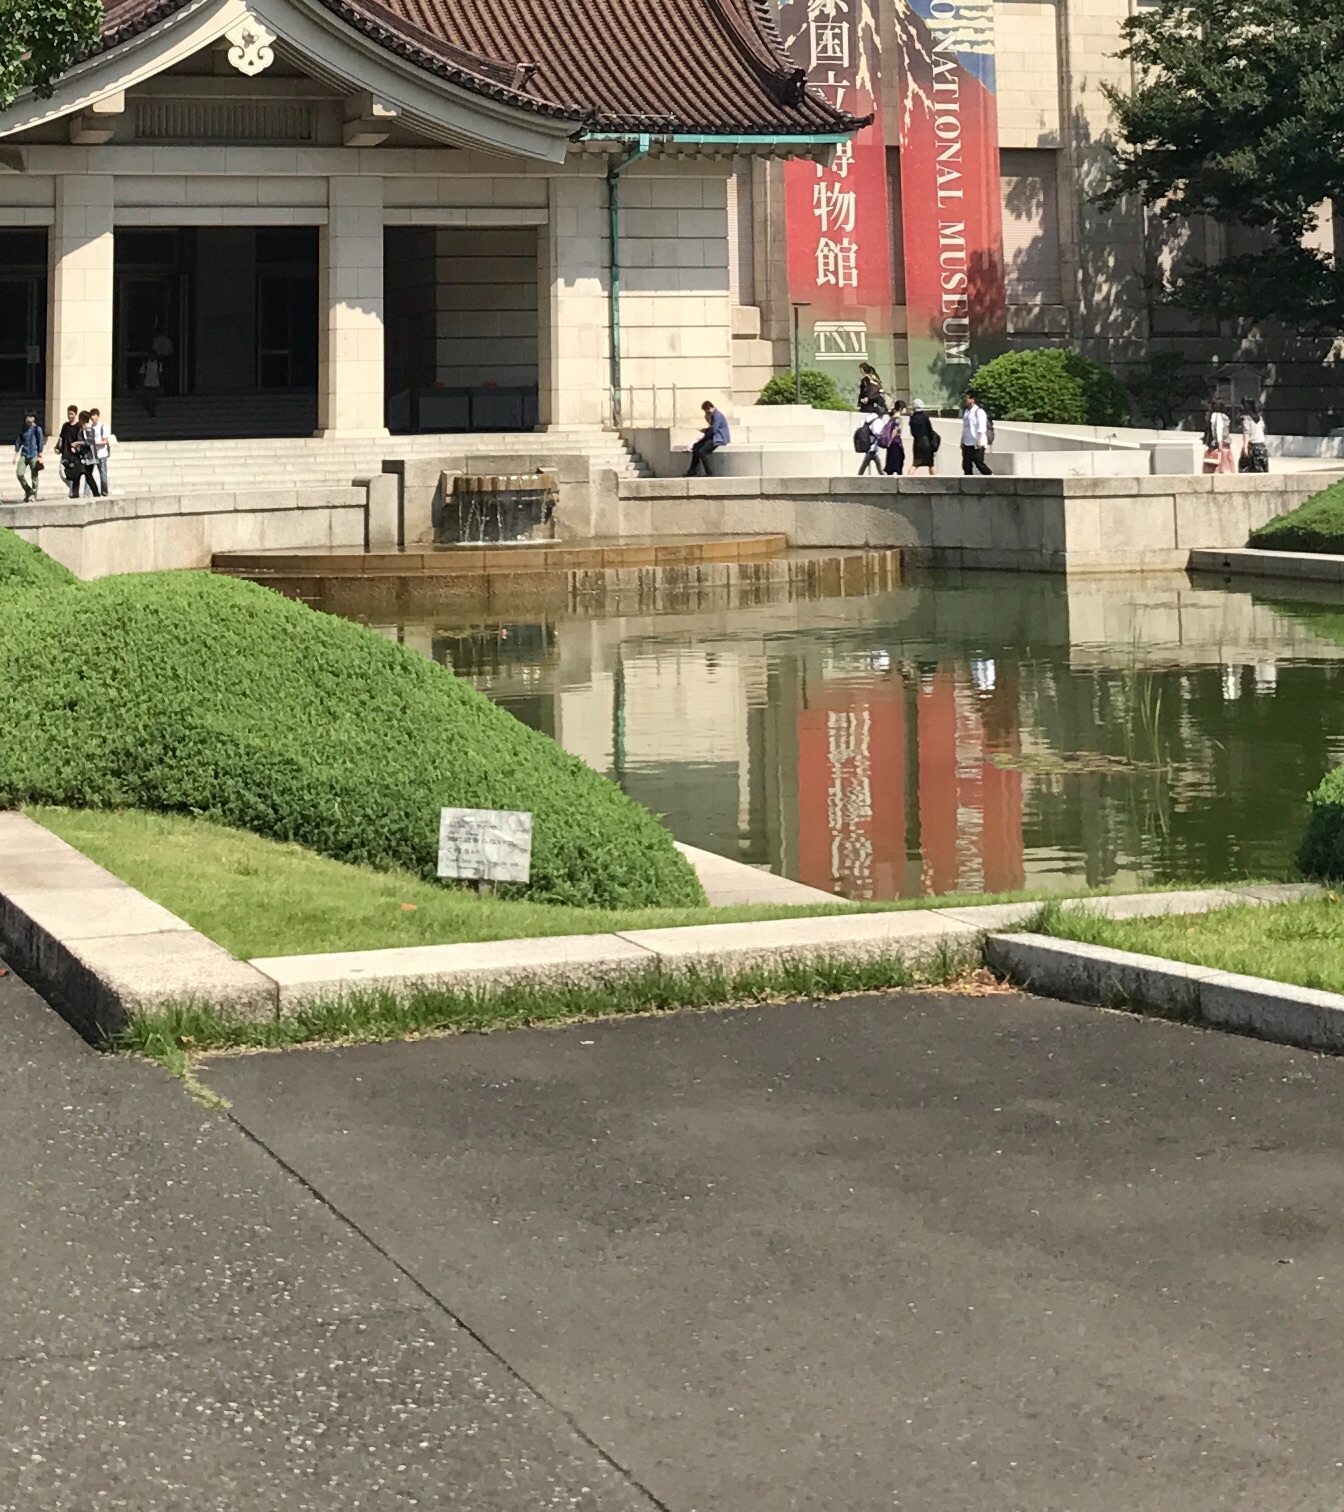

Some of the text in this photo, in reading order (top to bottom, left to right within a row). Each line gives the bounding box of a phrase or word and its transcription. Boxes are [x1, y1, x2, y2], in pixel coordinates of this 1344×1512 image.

[930, 30, 965, 209] NATIONAL
[814, 330, 867, 353] TNM
[937, 219, 972, 367] MUSEUM
